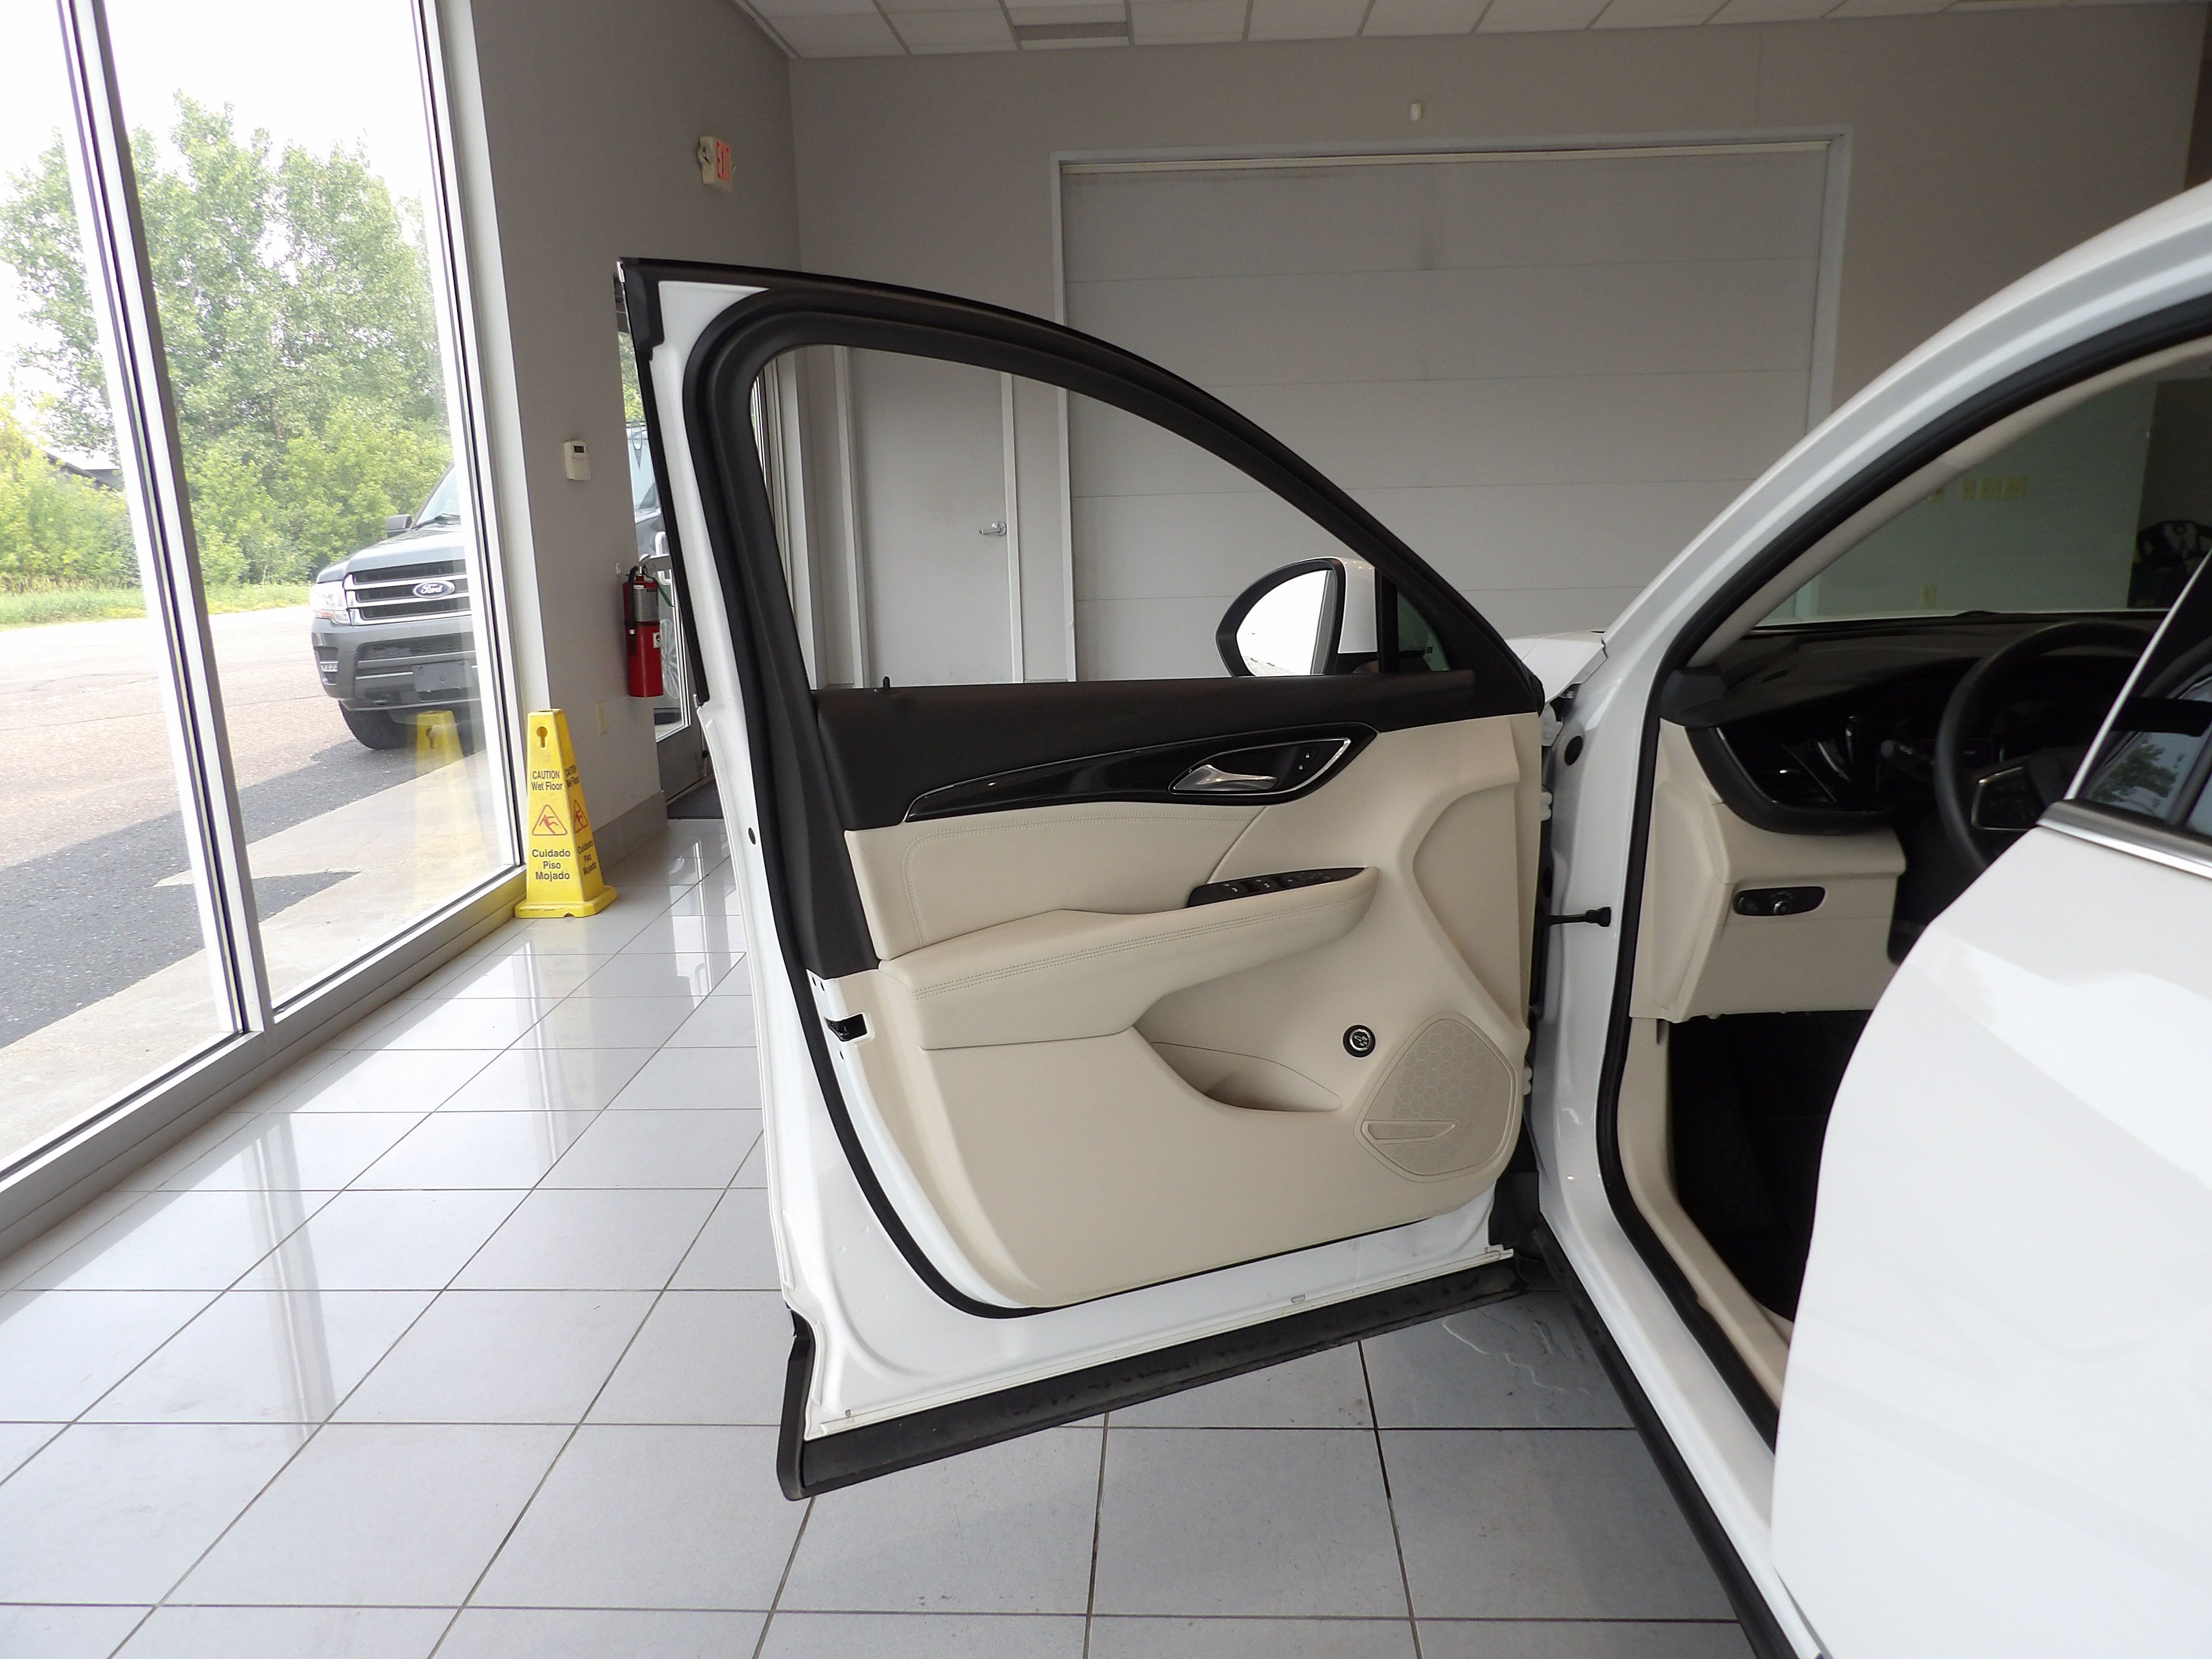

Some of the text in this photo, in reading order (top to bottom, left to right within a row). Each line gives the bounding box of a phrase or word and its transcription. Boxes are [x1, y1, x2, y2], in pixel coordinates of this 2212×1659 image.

[421, 584, 443, 594] Ford
[532, 770, 560, 779] CAUTION
[531, 781, 563, 791] Wet Floor
[532, 849, 571, 857] Cuidado
[543, 861, 561, 869] Piso
[535, 871, 570, 882] Mojado
